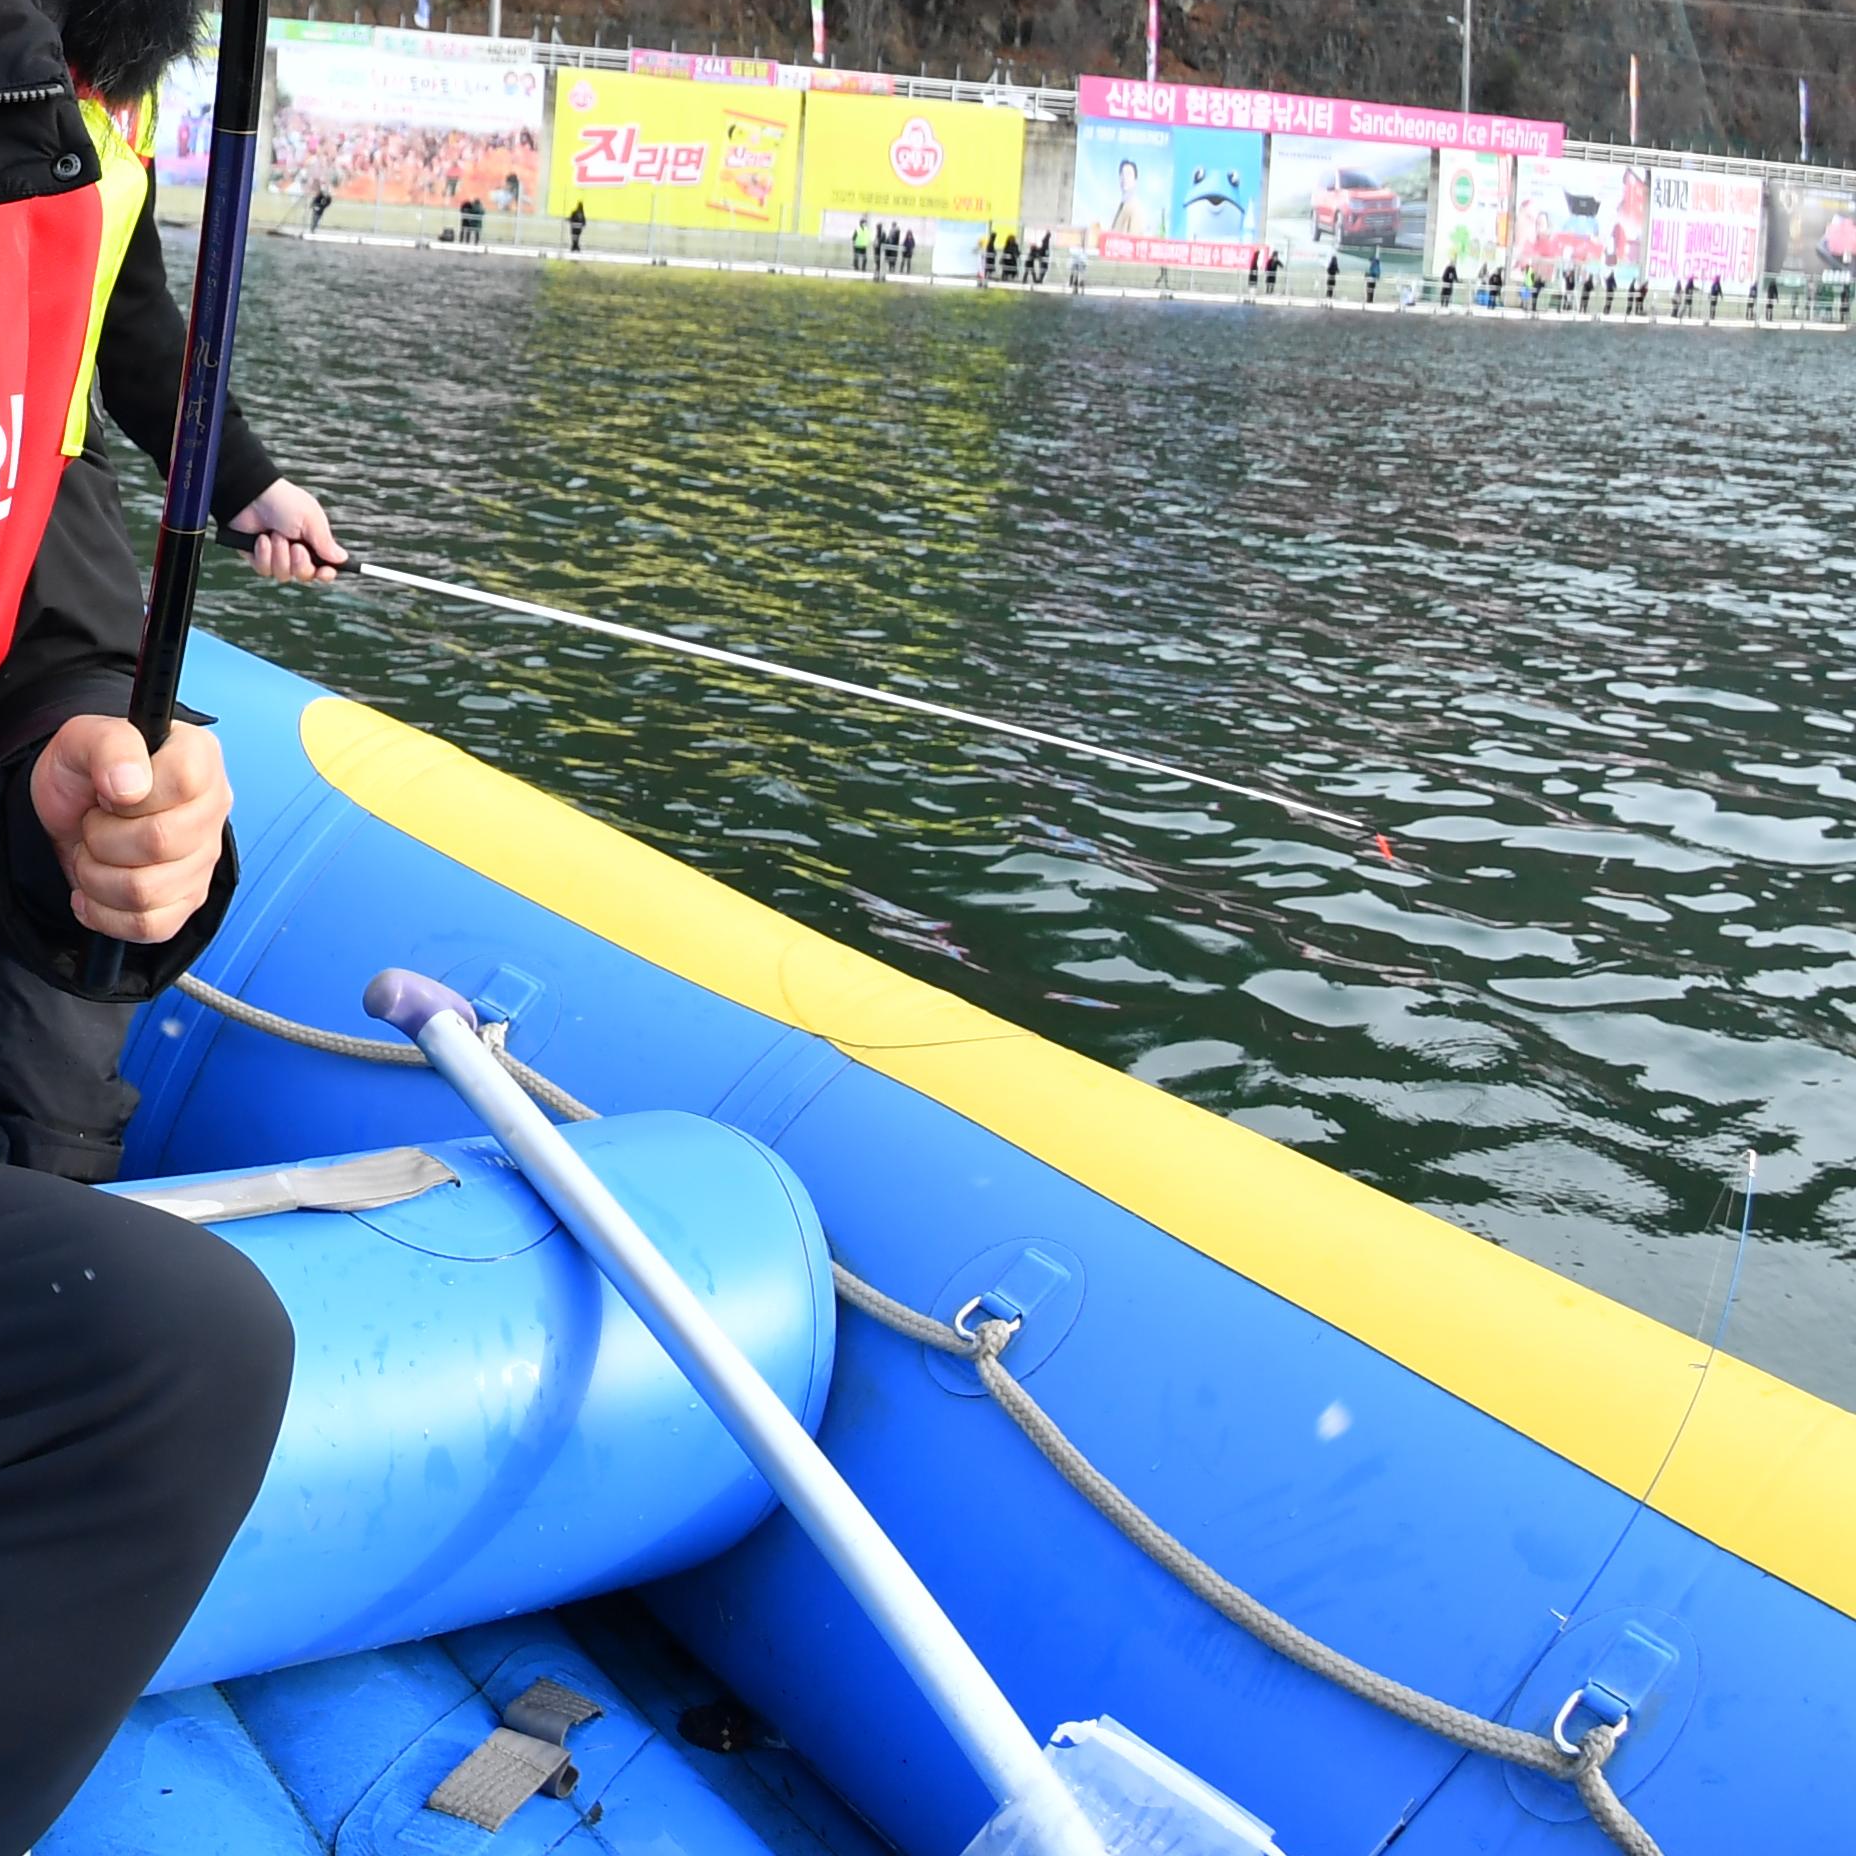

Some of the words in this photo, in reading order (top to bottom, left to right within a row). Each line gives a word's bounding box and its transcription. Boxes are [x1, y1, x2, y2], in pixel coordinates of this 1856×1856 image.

[1106, 82, 1176, 121] 산천어
[1186, 87, 1334, 134] 현장얼음낚시터
[1349, 104, 1458, 143] Sancheoneo
[1463, 118, 1486, 146] Ice
[1490, 119, 1549, 156] Fishing
[574, 126, 707, 186] 진라면
